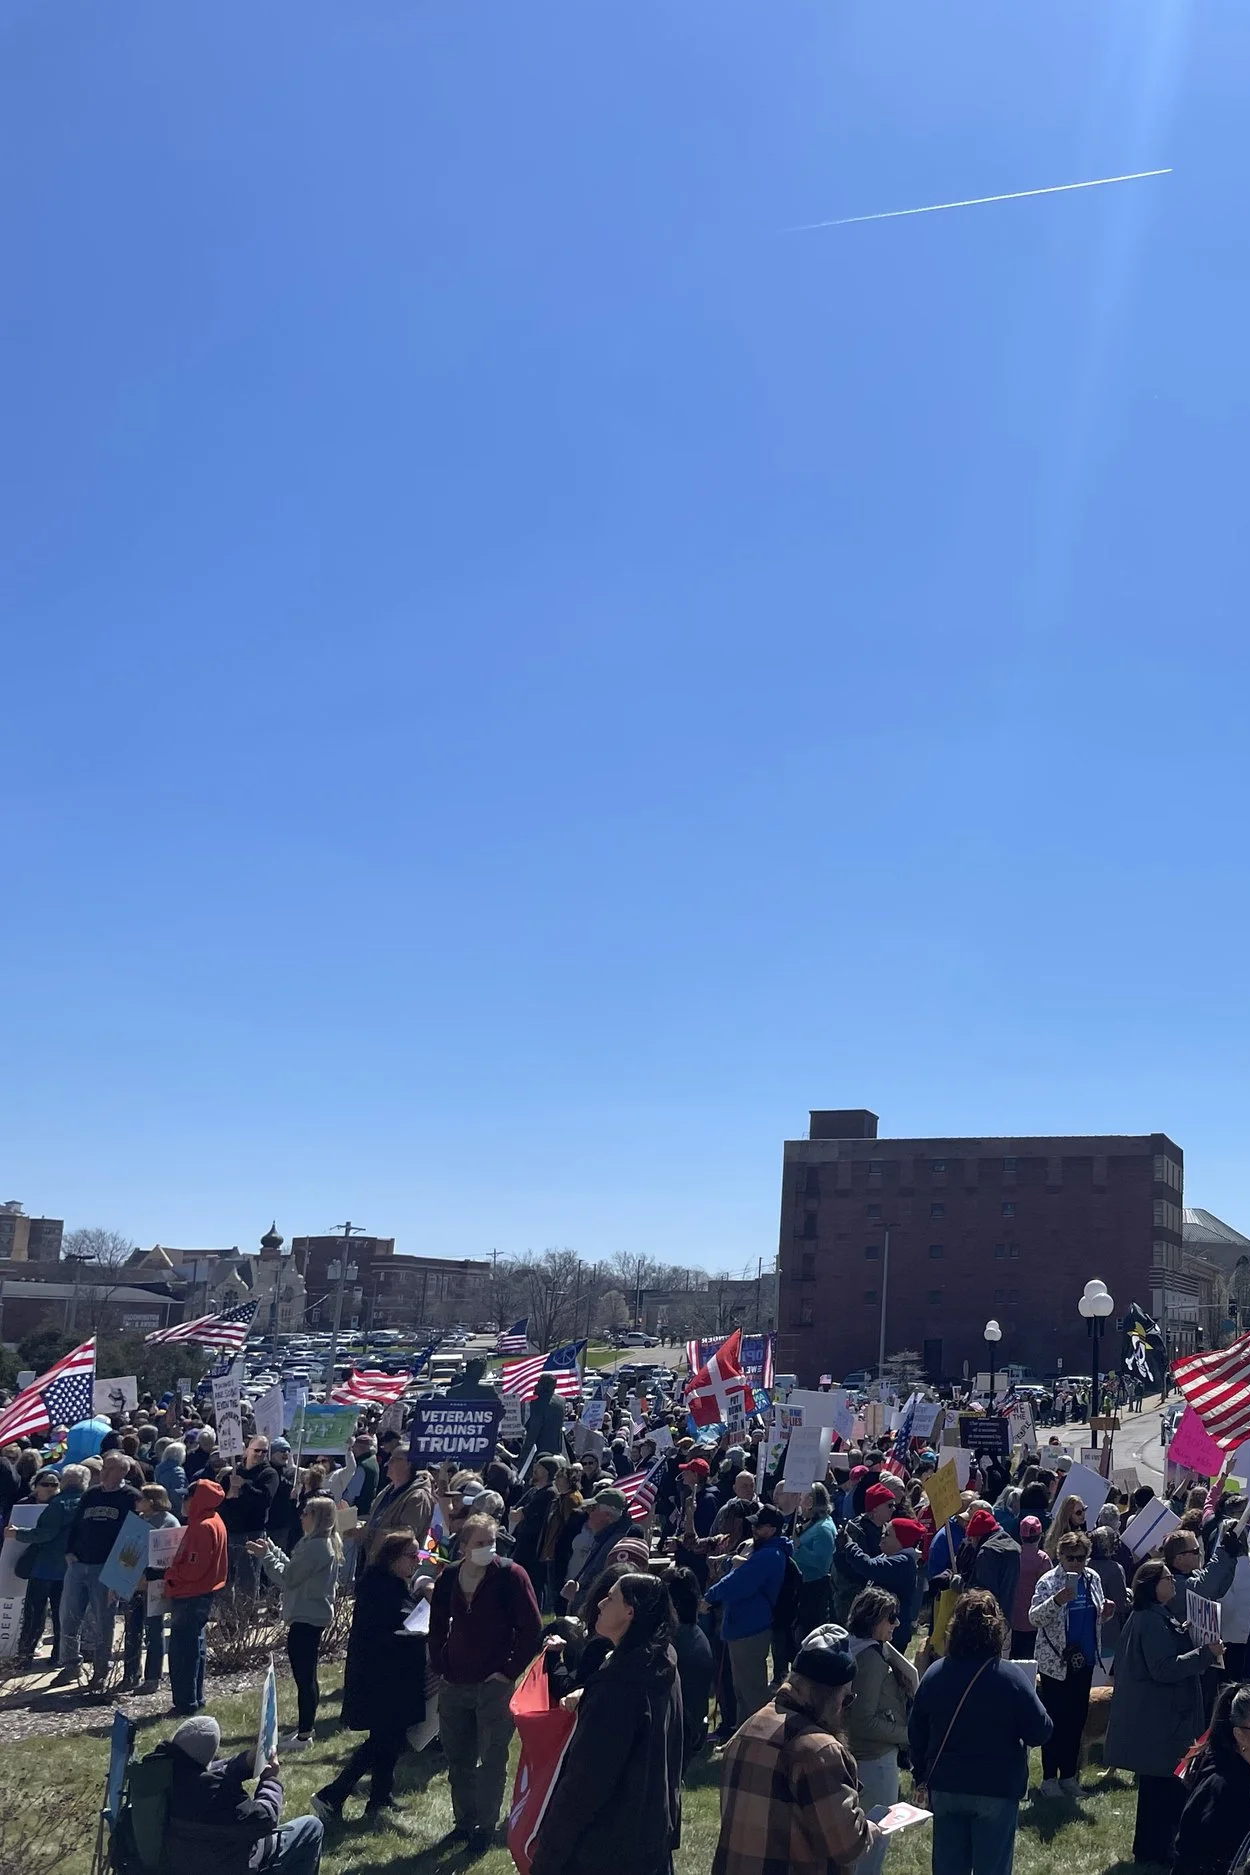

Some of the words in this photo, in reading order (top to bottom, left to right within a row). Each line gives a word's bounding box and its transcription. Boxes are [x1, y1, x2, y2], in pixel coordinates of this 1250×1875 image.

[420, 1410, 494, 1424] VETERANS
[424, 1424, 485, 1435] AGAINST
[417, 1437, 490, 1453] TRUMP
